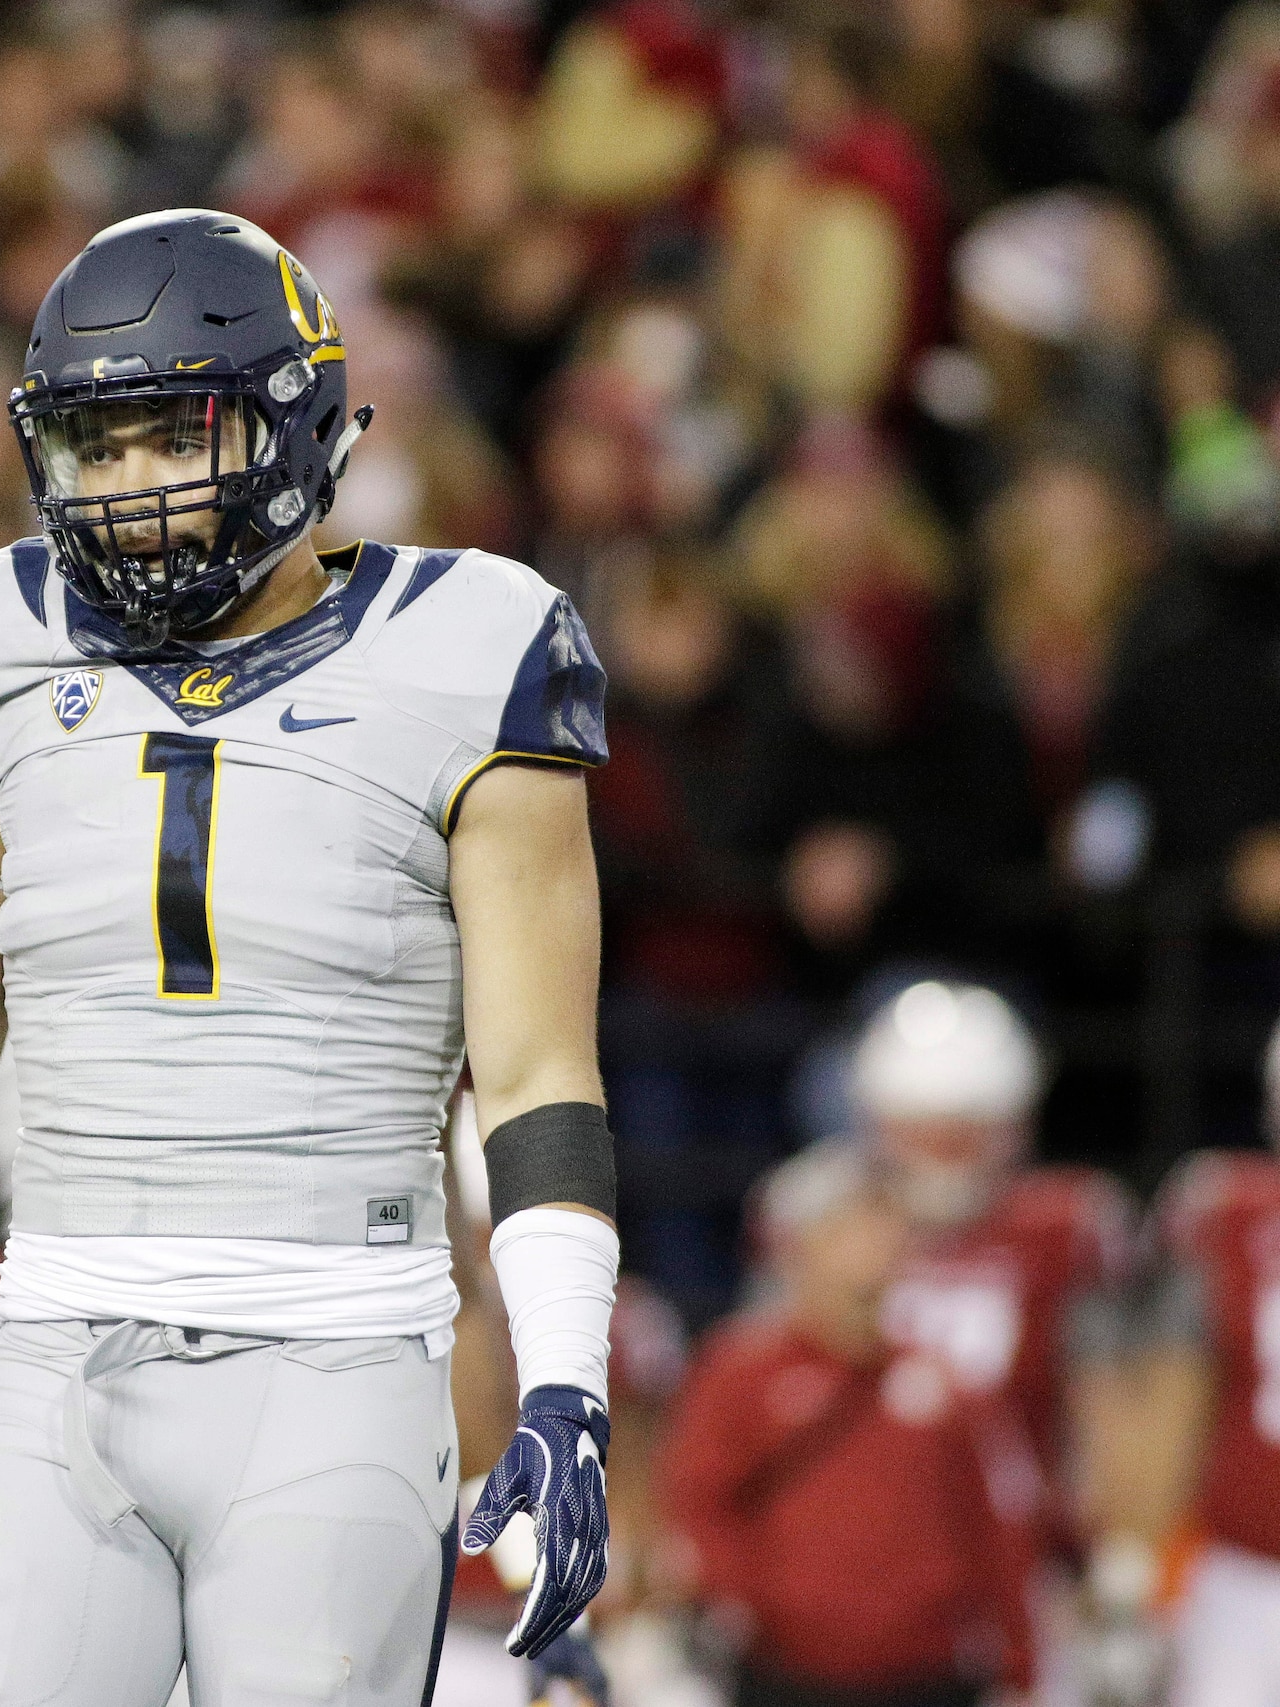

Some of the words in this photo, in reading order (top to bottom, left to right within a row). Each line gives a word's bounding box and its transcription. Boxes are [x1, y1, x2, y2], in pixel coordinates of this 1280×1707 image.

[52, 671, 99, 708] PAC
[174, 667, 233, 706] Cal
[58, 695, 85, 719] 12
[137, 732, 225, 1001] 1
[379, 1204, 399, 1220] 40
